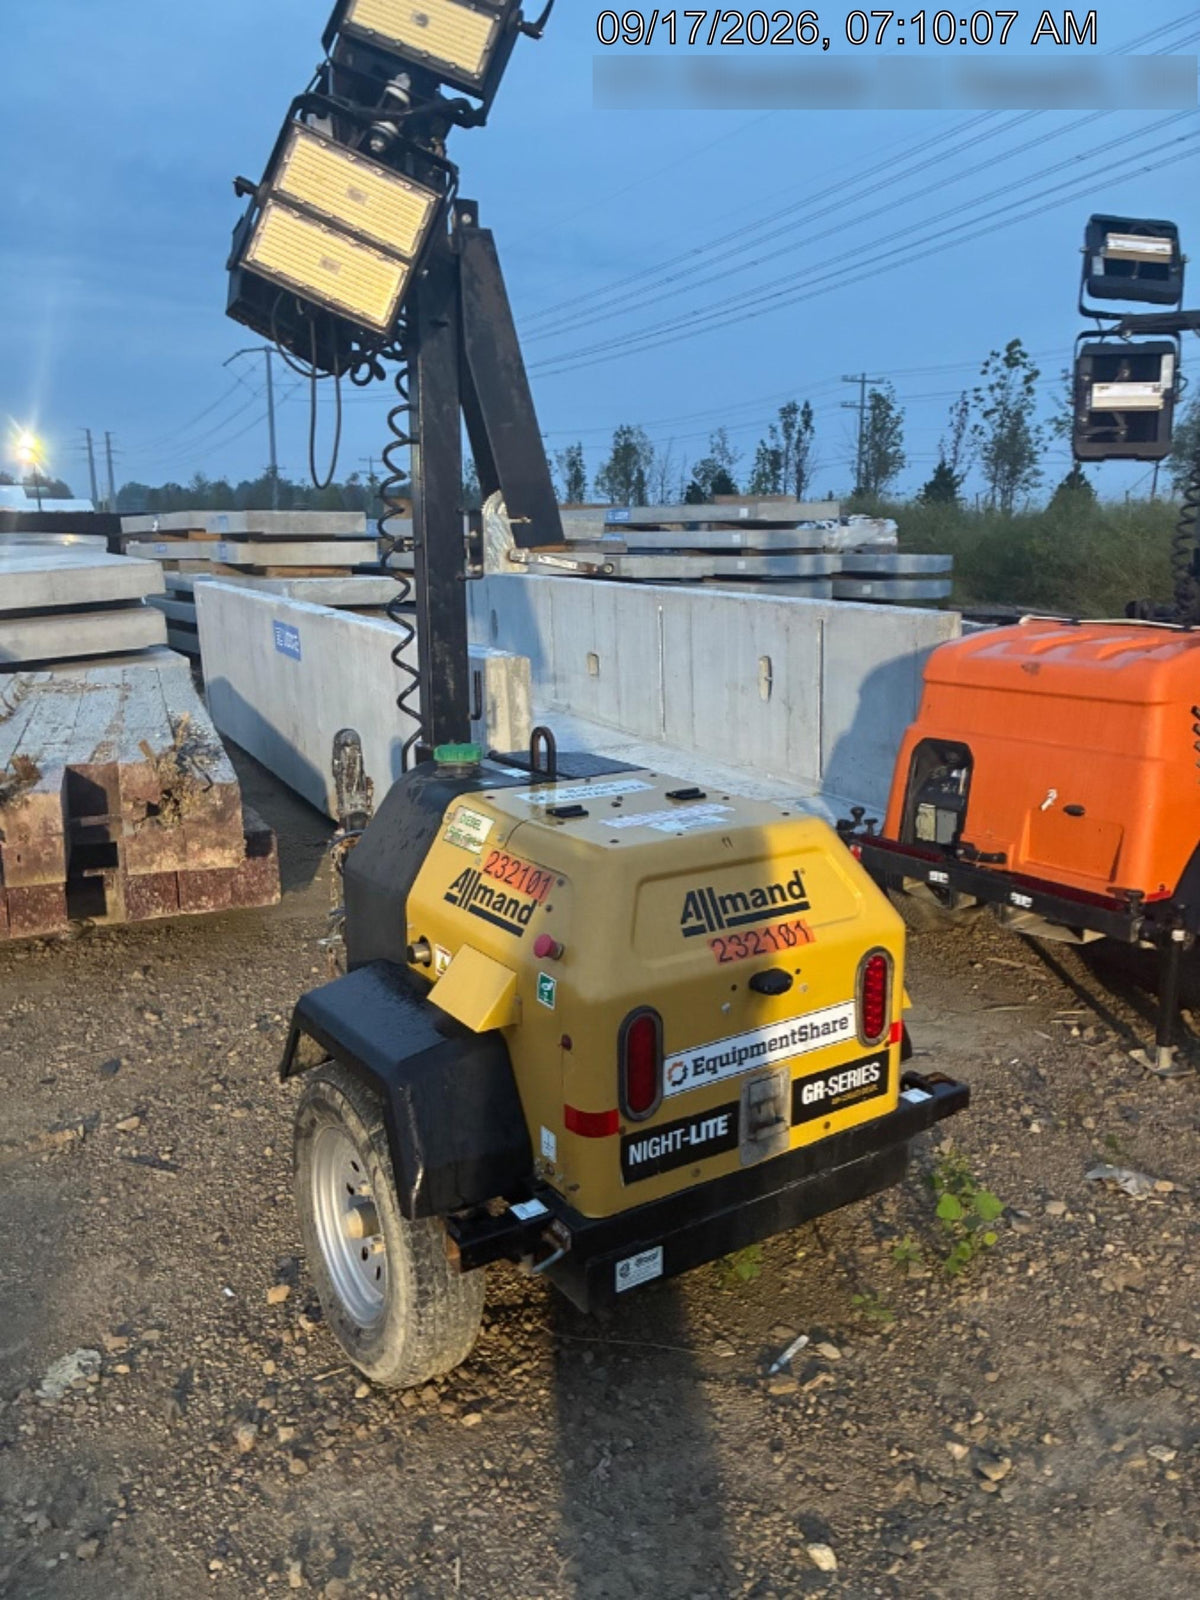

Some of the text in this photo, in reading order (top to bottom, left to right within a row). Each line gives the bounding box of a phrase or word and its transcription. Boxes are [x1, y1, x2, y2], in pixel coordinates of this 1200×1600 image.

[448, 867, 538, 926] Allmand
[484, 850, 552, 900] 232101
[681, 869, 806, 932] Allmand
[711, 920, 811, 963] 232101
[692, 1016, 849, 1077] EquipmentShare
[802, 1062, 880, 1105] GR-SERIES
[628, 1114, 728, 1166] NIGHT-LITE
